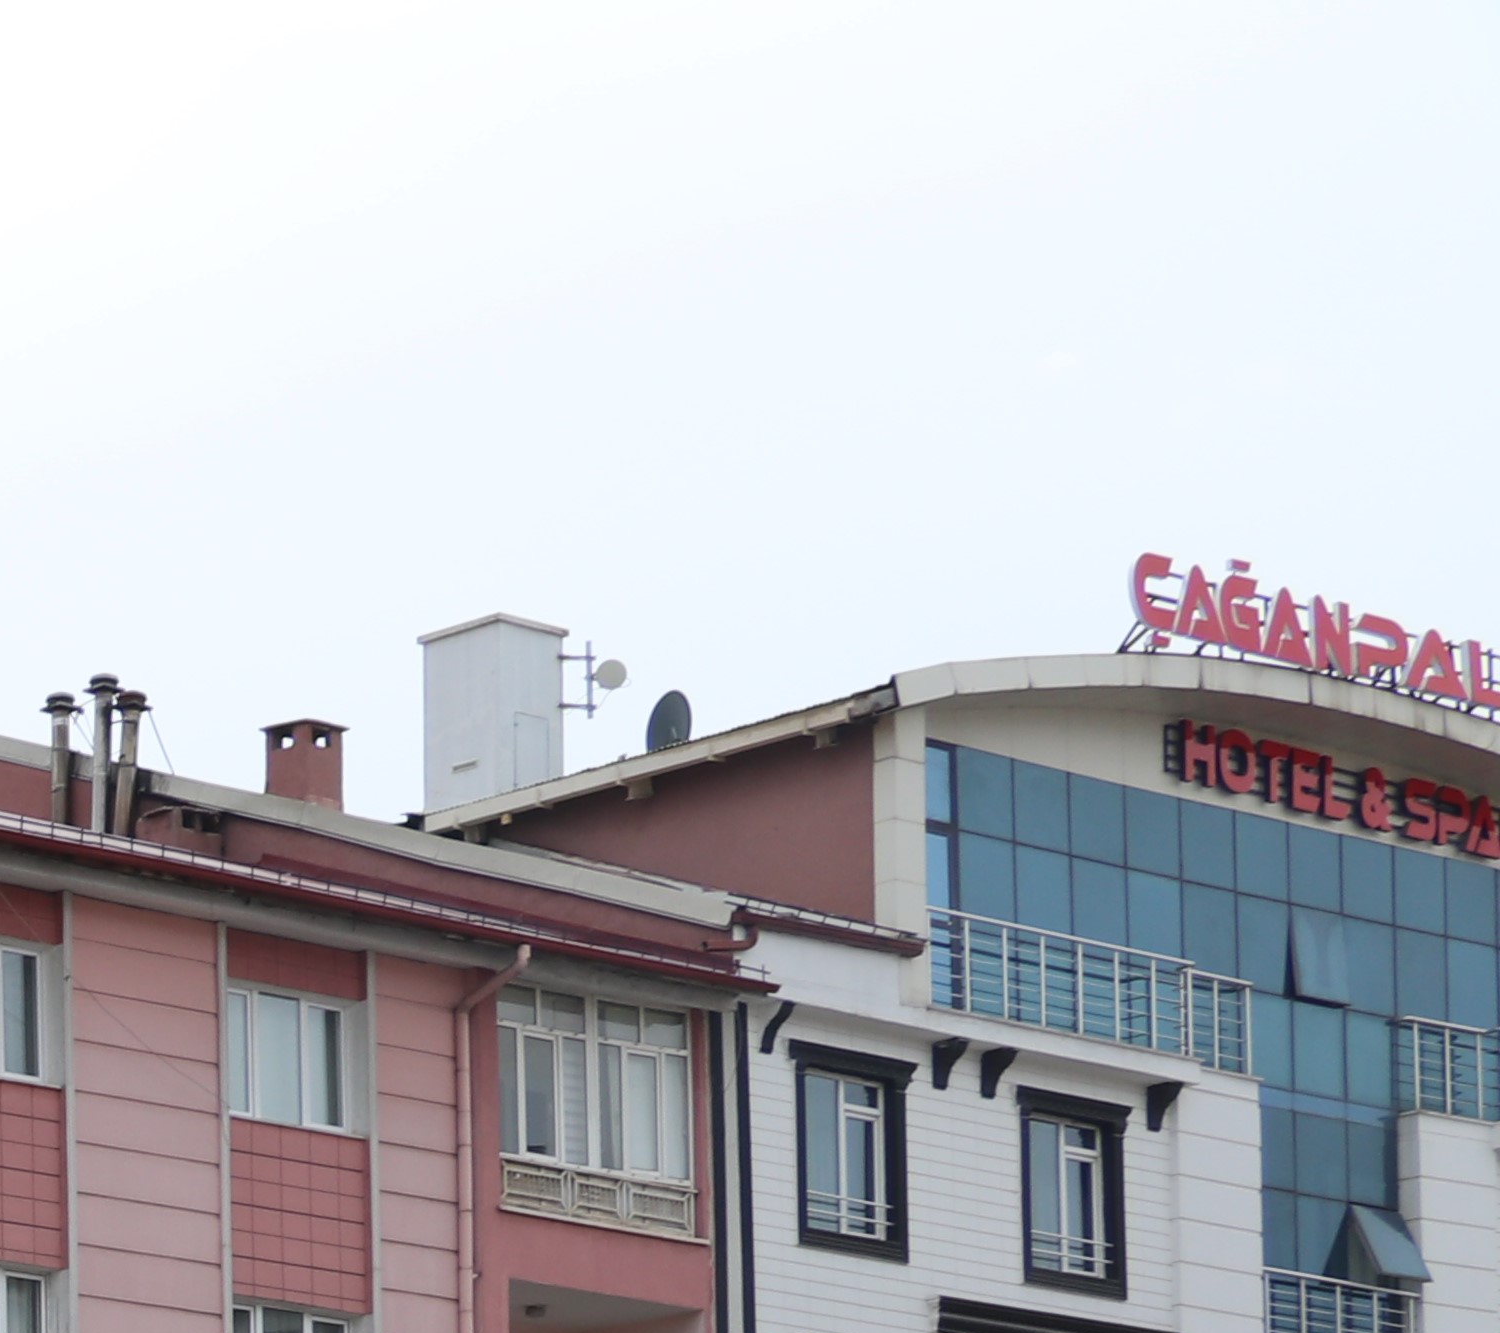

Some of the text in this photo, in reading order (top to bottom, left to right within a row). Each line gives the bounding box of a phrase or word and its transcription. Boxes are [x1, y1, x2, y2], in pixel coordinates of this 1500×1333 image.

[1128, 551, 1500, 709] ÇAĞANPAL
[1178, 717, 1500, 860] HOTEL & SPA
